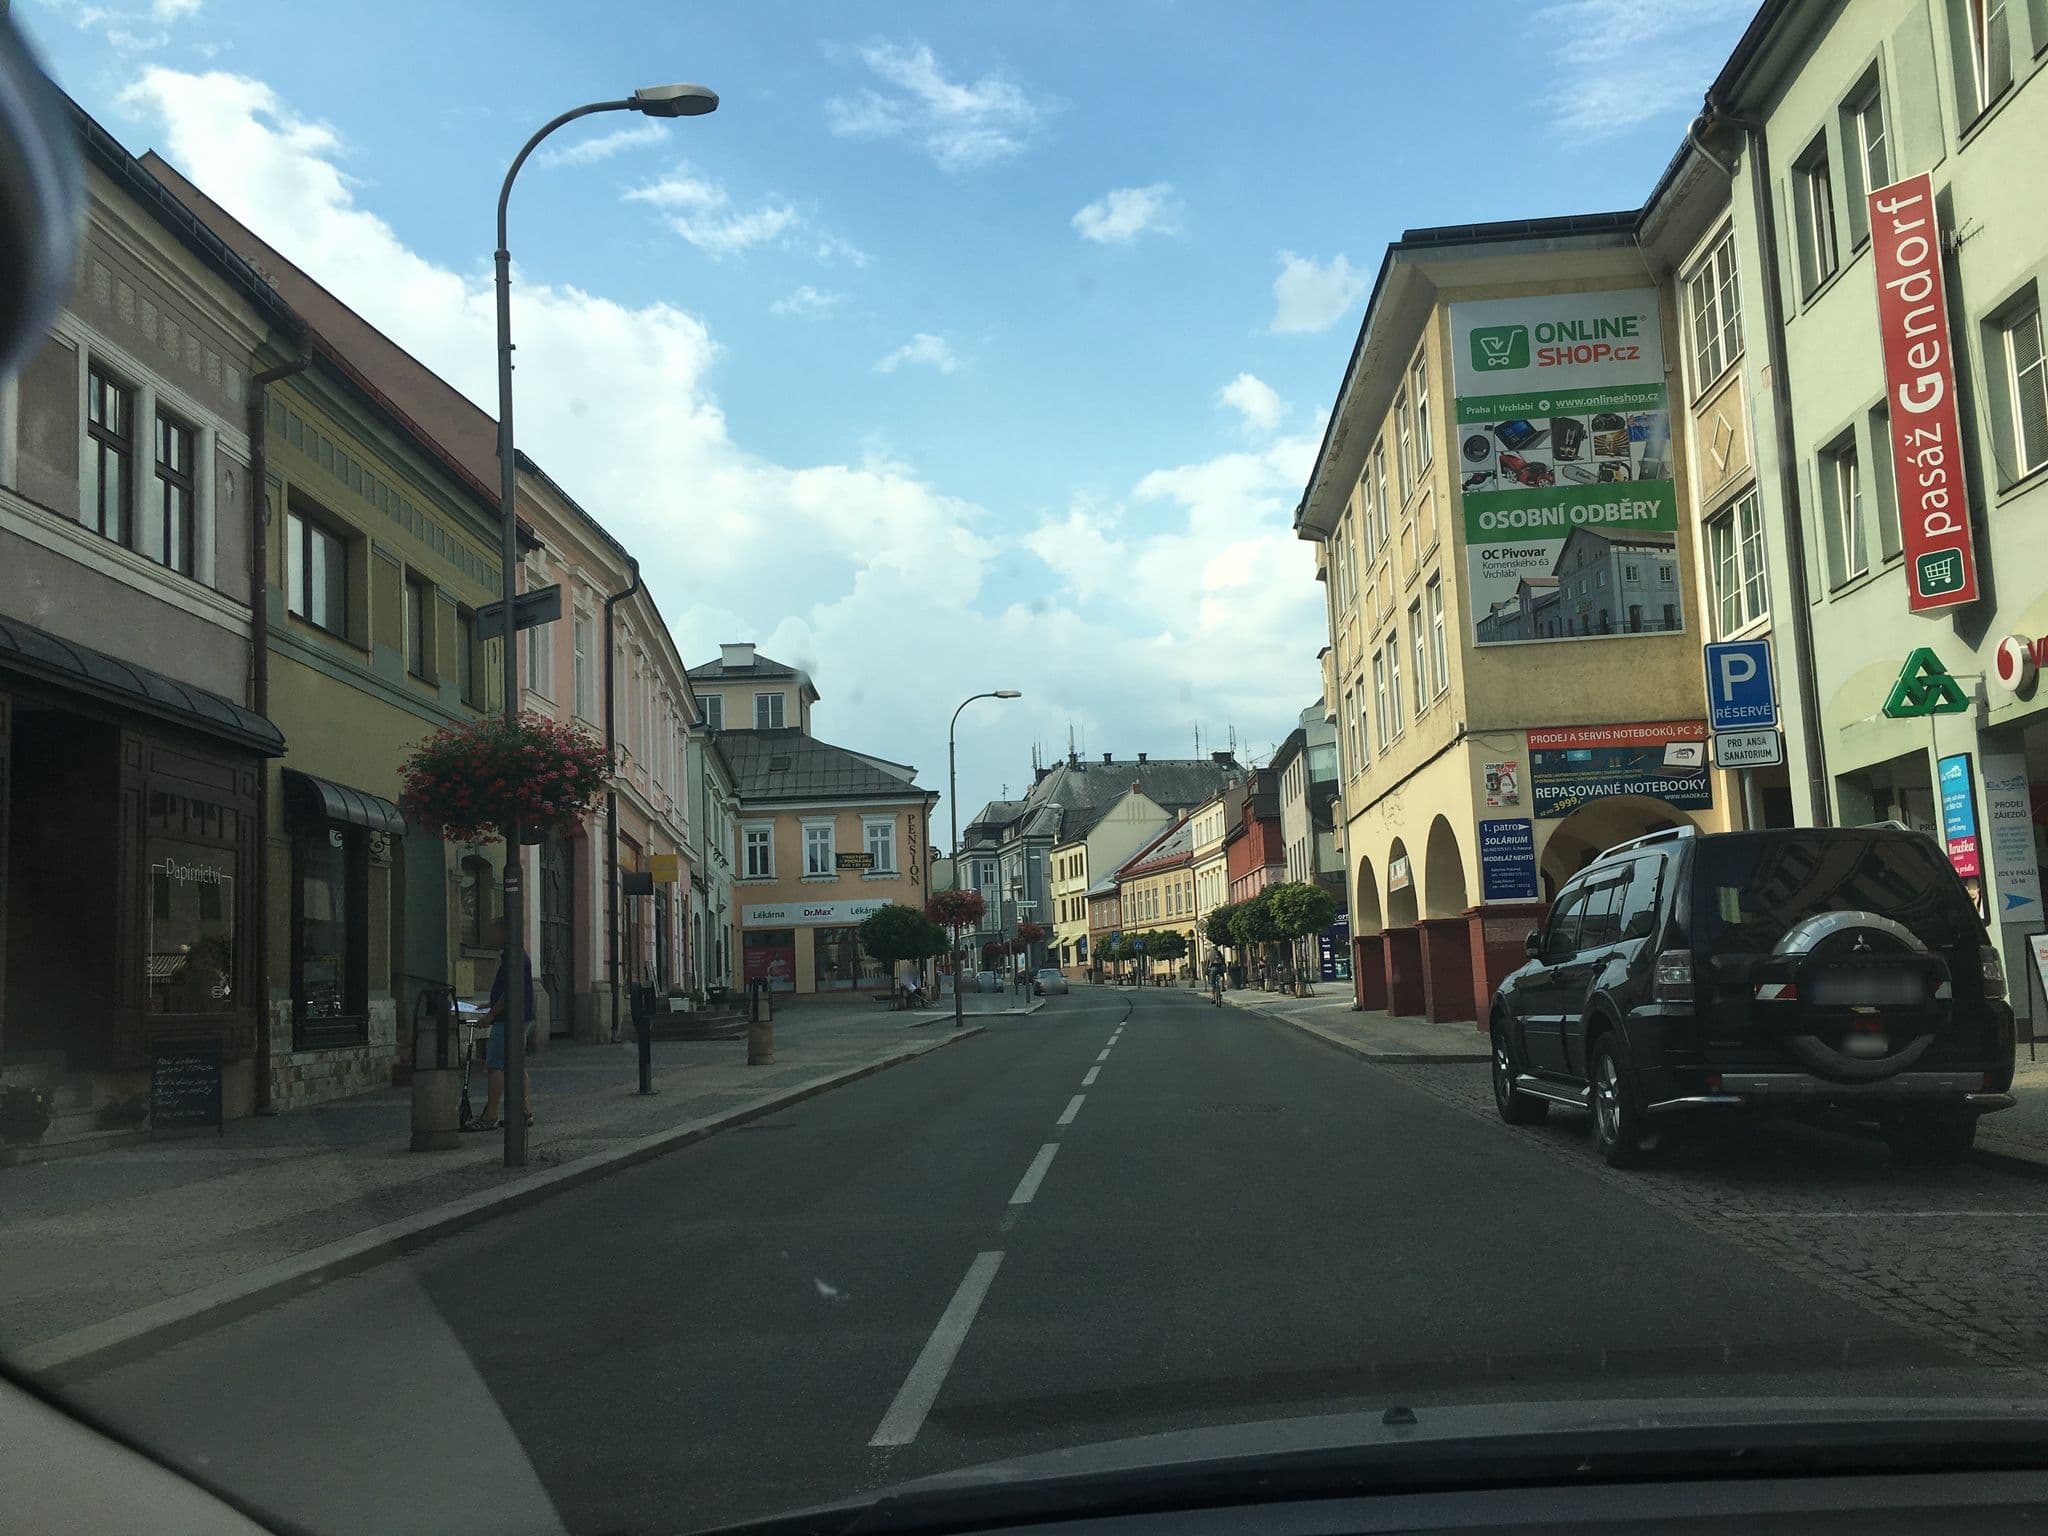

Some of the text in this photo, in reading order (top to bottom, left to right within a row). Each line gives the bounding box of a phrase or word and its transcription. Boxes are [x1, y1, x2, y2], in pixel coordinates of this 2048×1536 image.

[1534, 315, 1640, 344] ONLINE
[1537, 343, 1641, 367] SHOP.cz
[1876, 194, 1962, 538] pasáž Gendorf
[1466, 391, 1660, 415] Praha Vrchlabí www.onlineshop.cz
[1478, 498, 1662, 530] OSOBNÍ ODBĚRY
[1482, 547, 1546, 560] OC Pivovar
[1482, 558, 1550, 570] Komenského 63
[1482, 569, 1518, 579] Vrchlabí
[1720, 653, 1757, 701] P
[1716, 703, 1772, 719] RÉSERVÉ
[1530, 725, 1690, 744] PRODEJ A SERVIS NOTEBOOKŮ, PC
[1727, 736, 1768, 748] PRO ANSA
[1724, 749, 1773, 761] SANATORIUM
[1535, 781, 1622, 799] REPASOVANÉ
[1624, 778, 1706, 794] NOTEBOOKY
[1552, 796, 1585, 812] 3999,-
[1995, 800, 2024, 809] PRODEJ
[1994, 809, 2027, 819] ZÁJEZDŮ
[1484, 823, 1519, 834] 1. patro
[1484, 835, 1529, 845] SOLÁRIUM
[907, 814, 919, 887] PENSION
[166, 857, 222, 887] Papírnictví
[753, 910, 786, 920] Lékárna
[803, 907, 833, 918] Dr.Max
